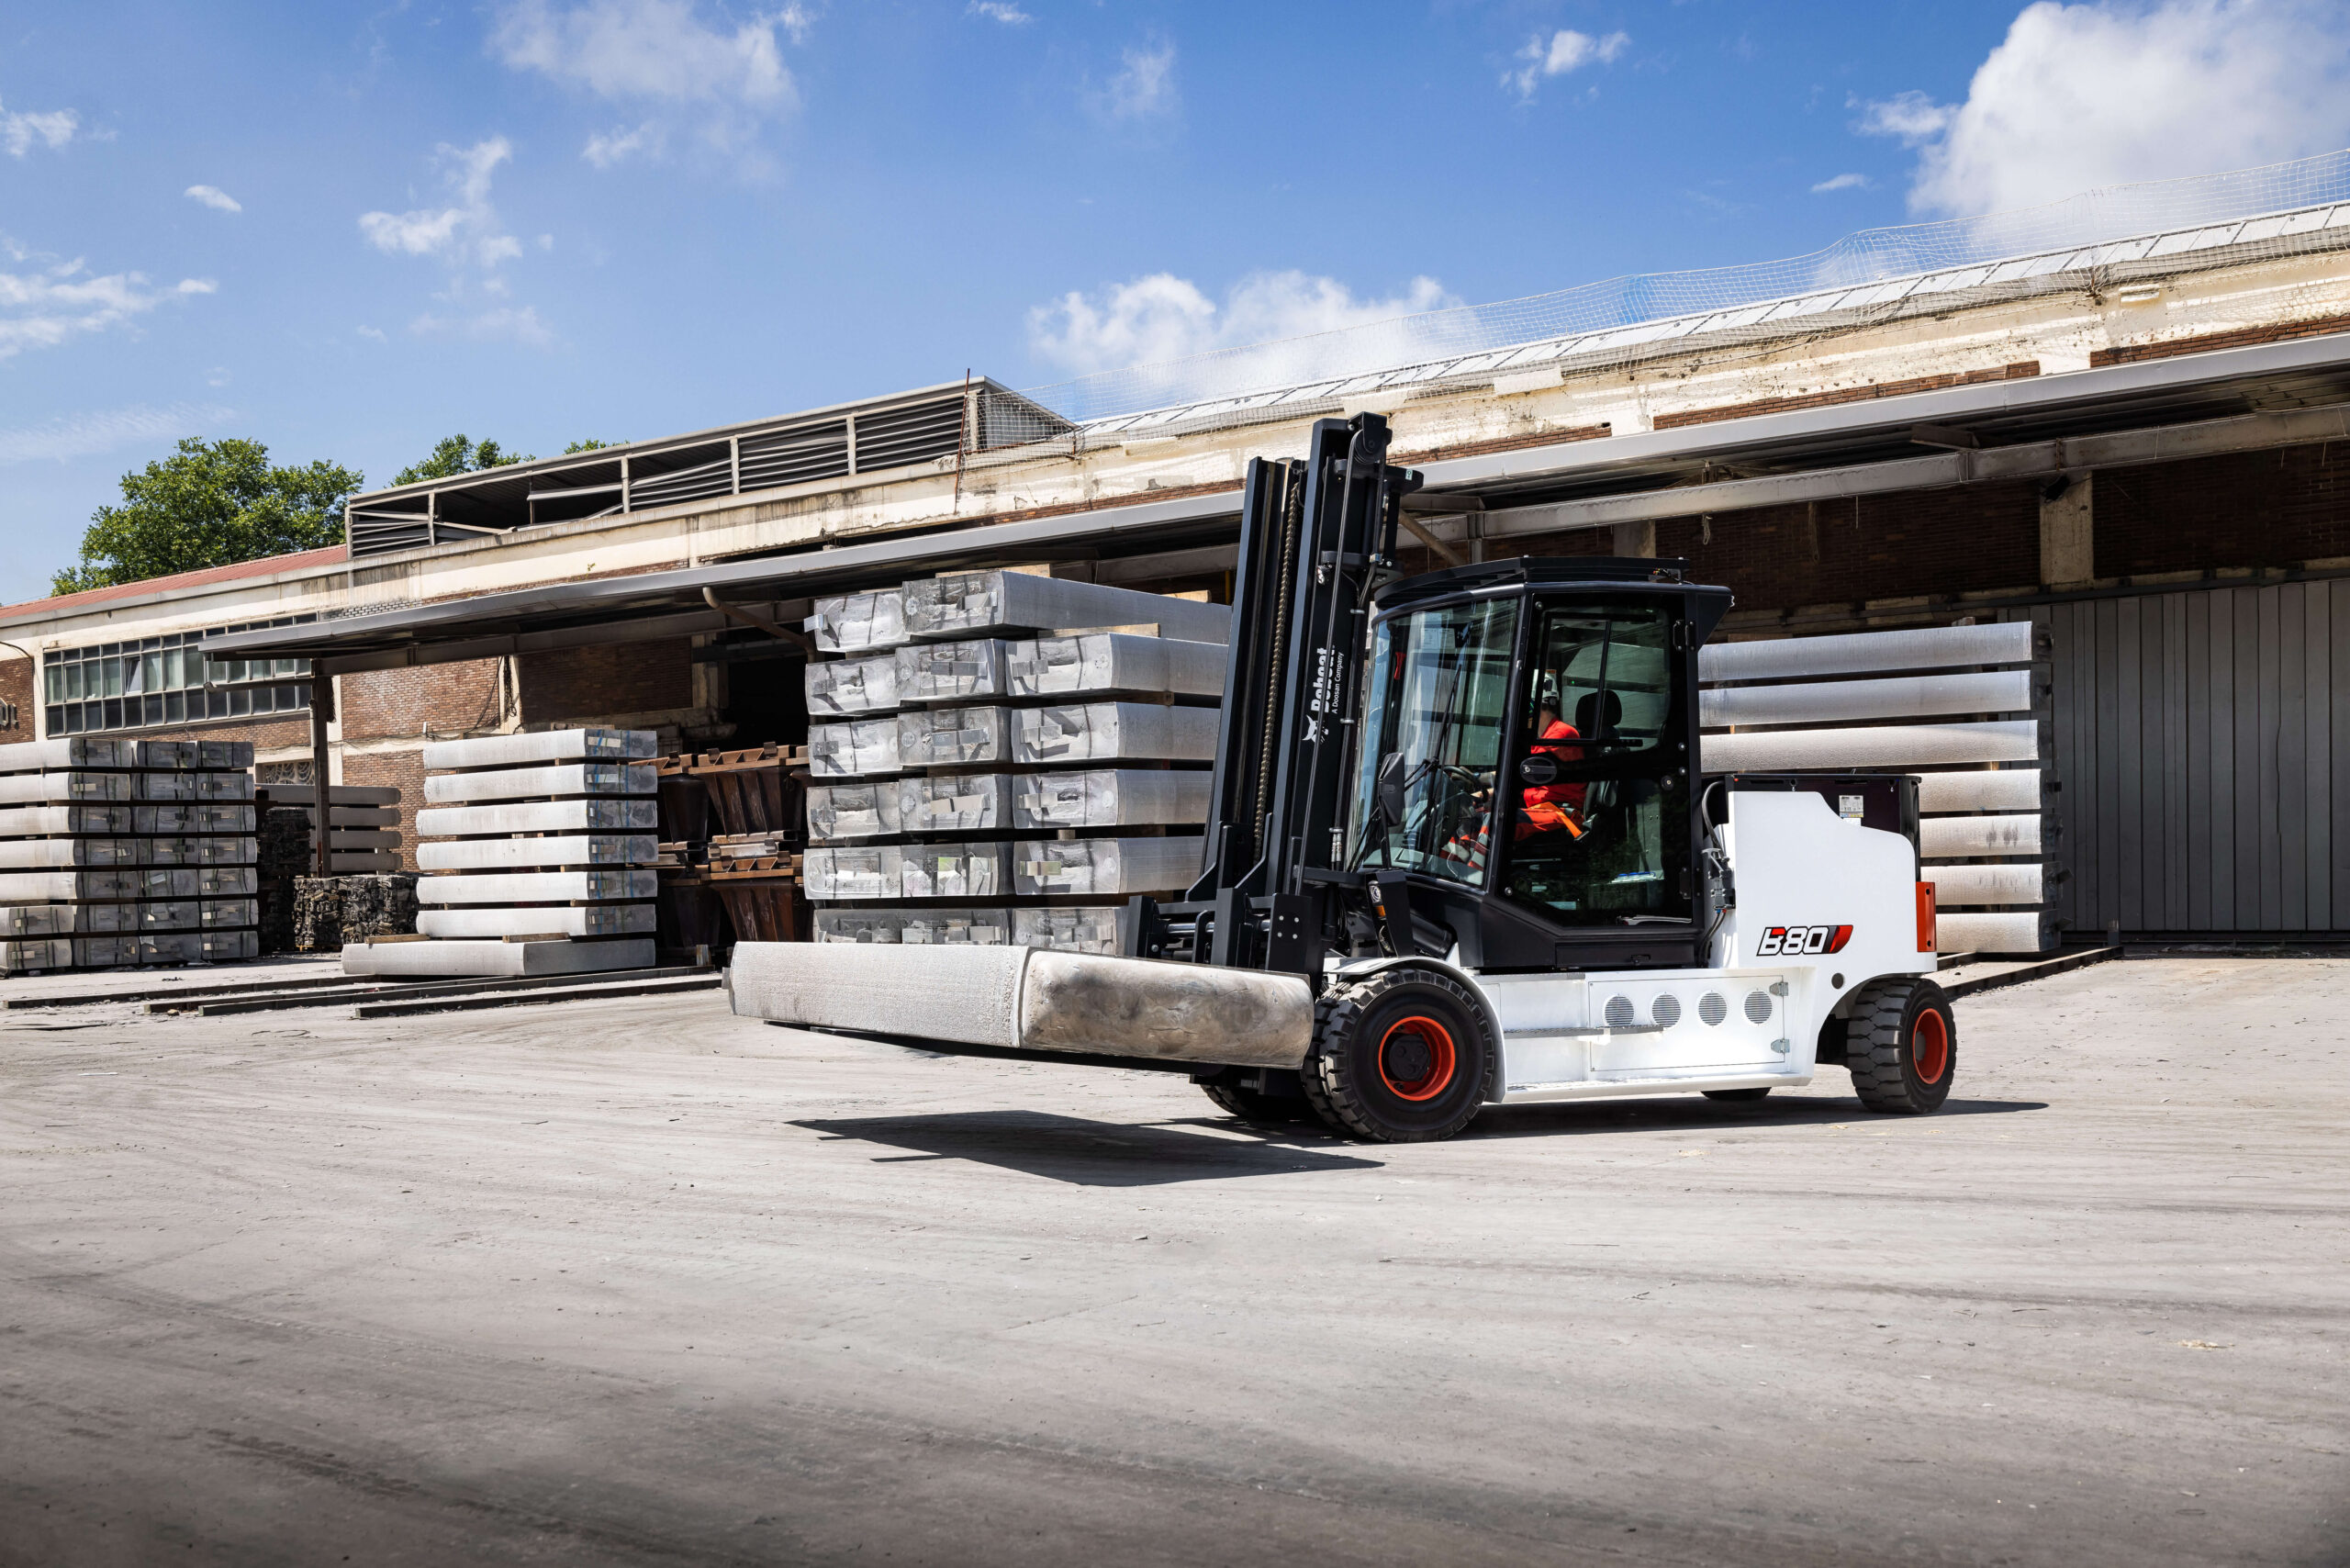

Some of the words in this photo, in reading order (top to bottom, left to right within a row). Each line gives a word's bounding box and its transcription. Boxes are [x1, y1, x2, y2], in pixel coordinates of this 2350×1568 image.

[1335, 652, 1345, 682] Company
[1332, 683, 1340, 708] Doosan
[1755, 925, 1830, 957] B80
